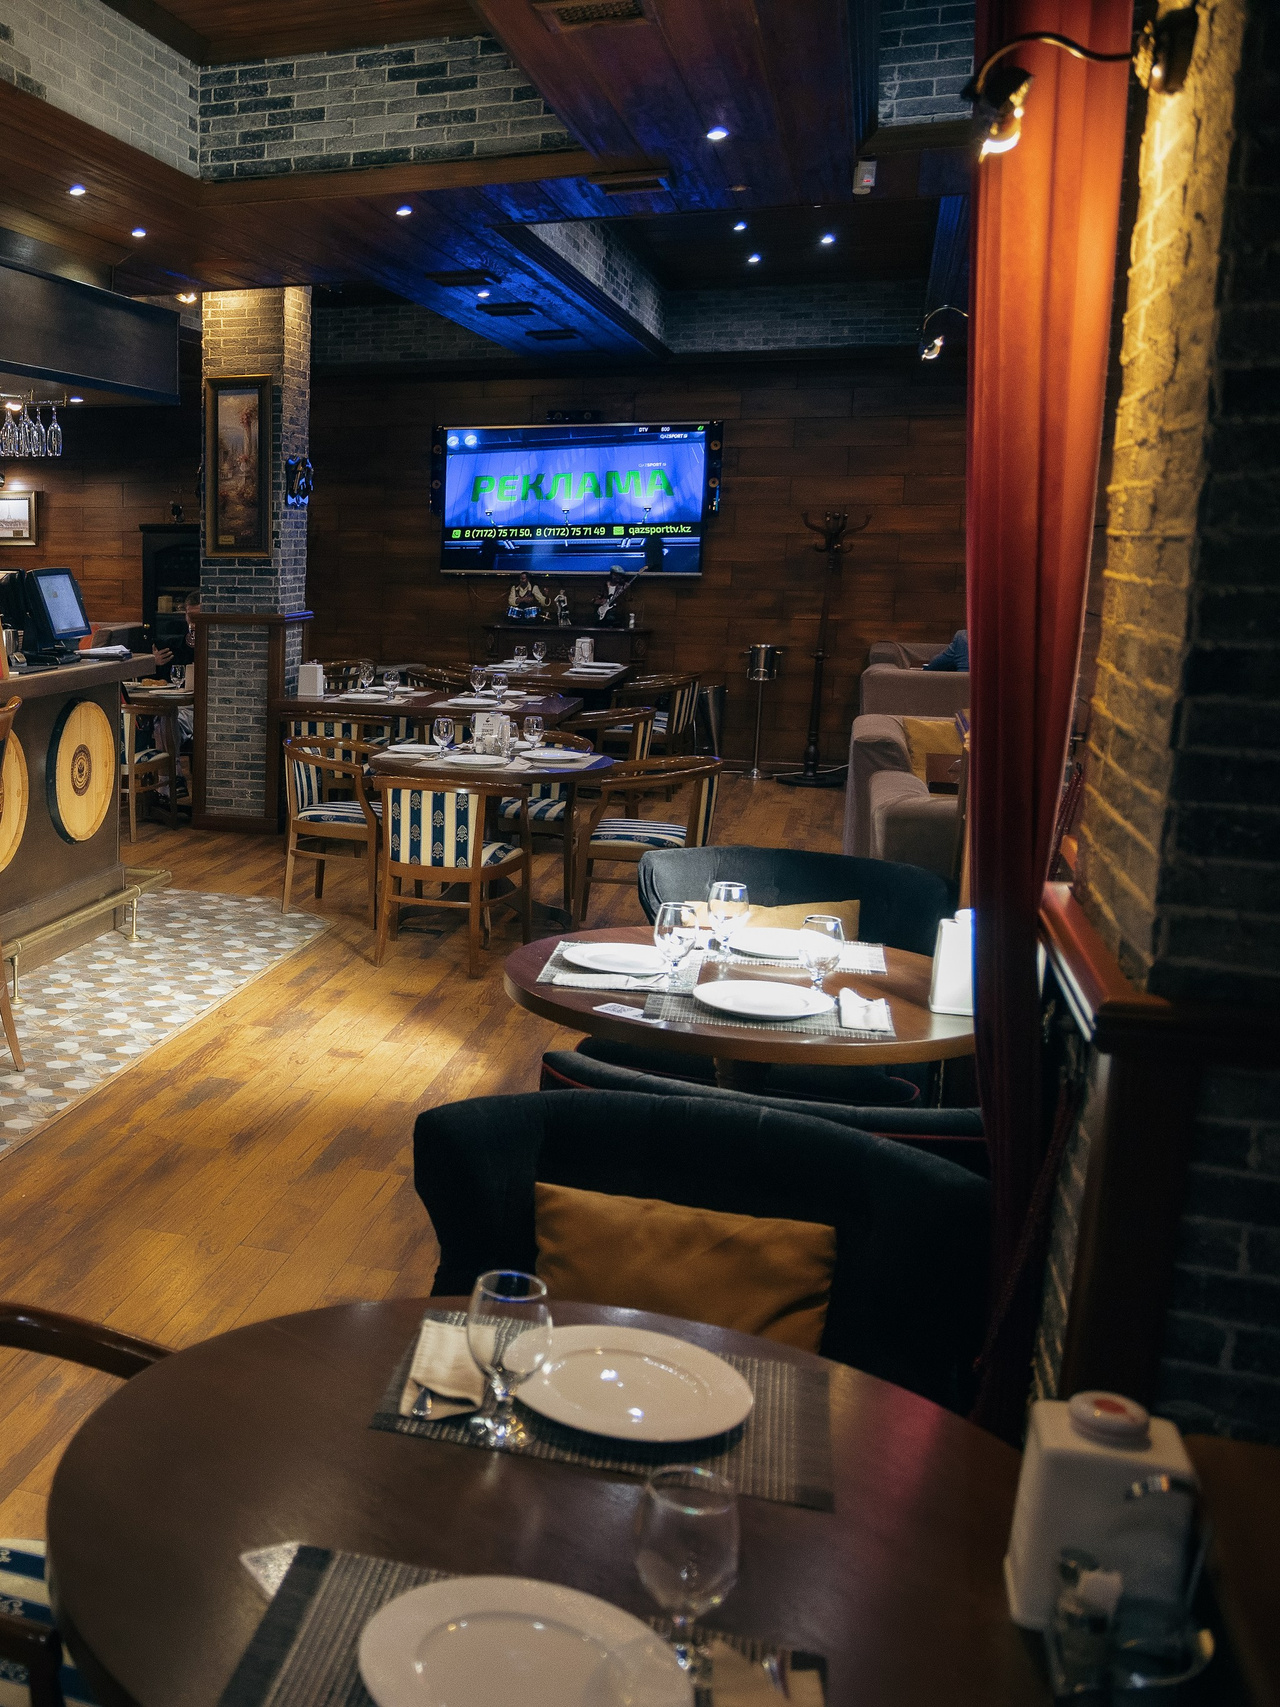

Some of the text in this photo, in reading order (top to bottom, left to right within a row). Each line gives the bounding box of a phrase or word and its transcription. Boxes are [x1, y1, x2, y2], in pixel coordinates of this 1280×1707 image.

[472, 469, 675, 503] РЕКЛАМА
[464, 526, 606, 539] 8 (7172) 75 71 50, 8 (7172) 75 71 49
[628, 524, 692, 536] qazsporttv.kz
